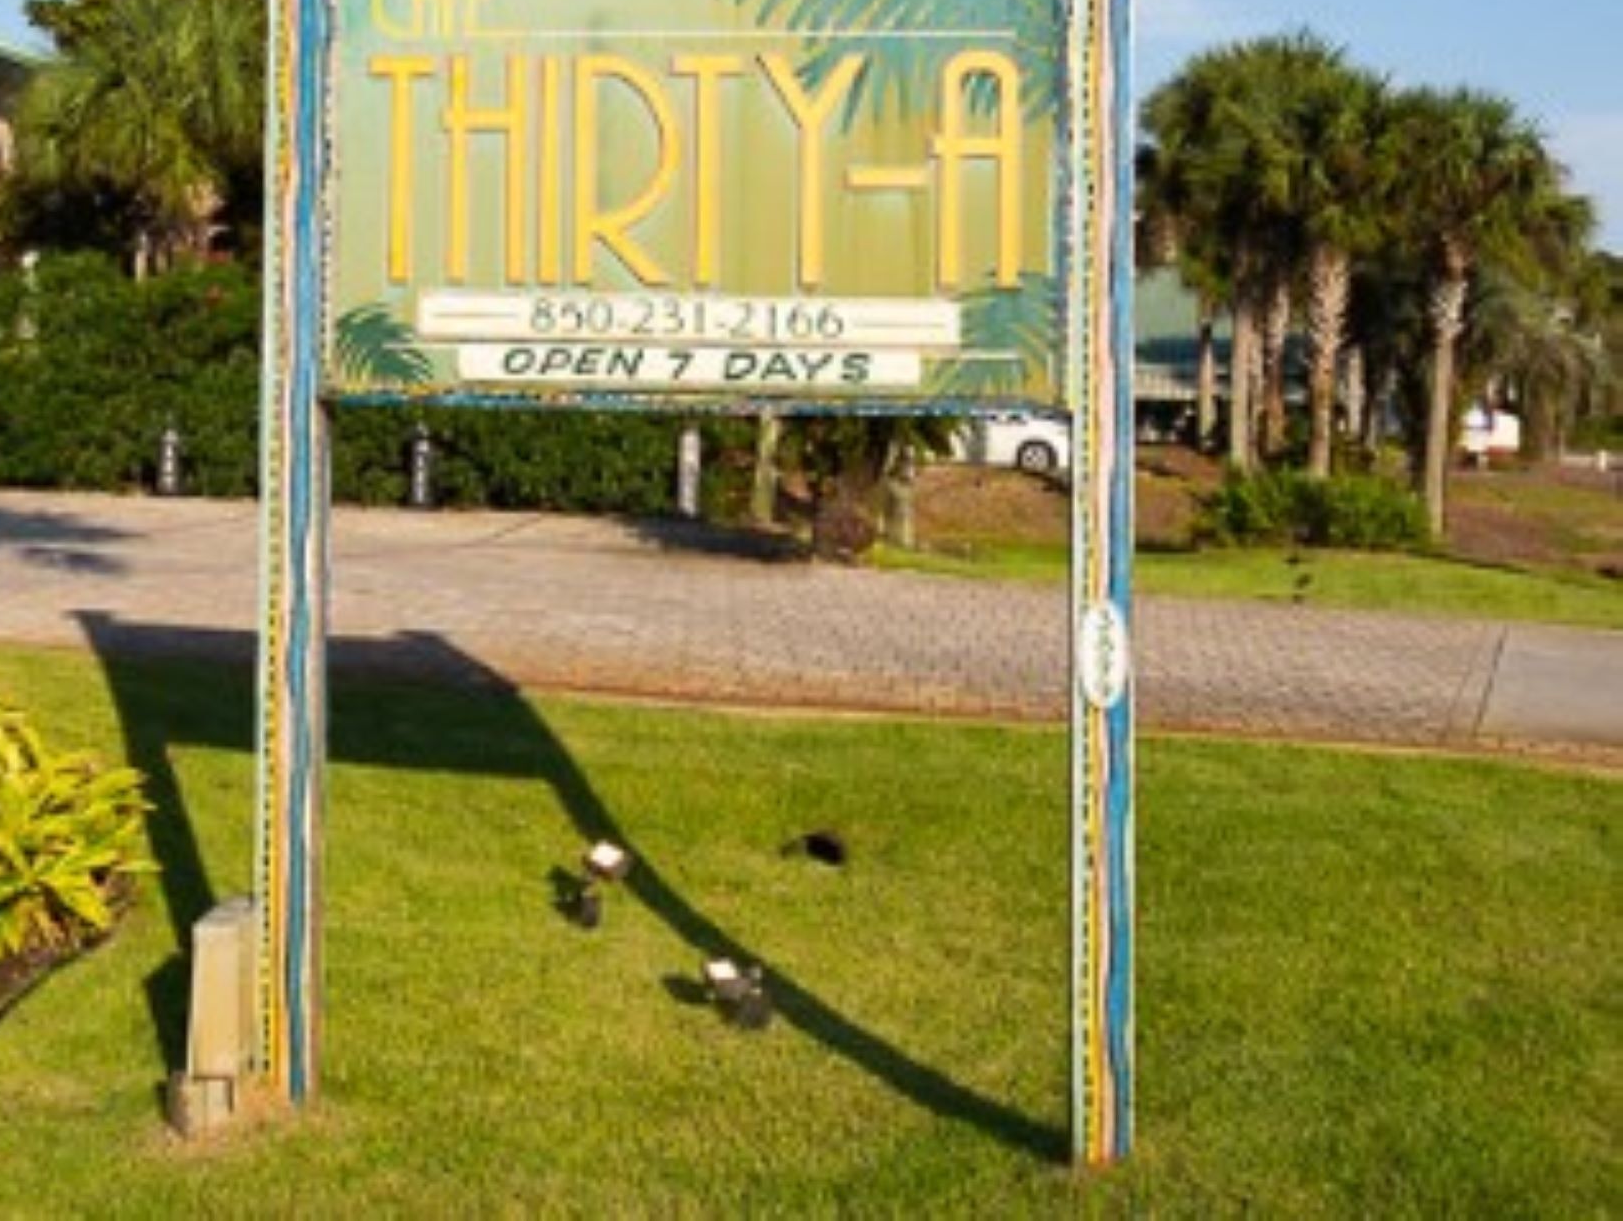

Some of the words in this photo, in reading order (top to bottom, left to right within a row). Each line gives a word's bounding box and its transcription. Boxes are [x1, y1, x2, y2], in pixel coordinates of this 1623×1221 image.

[370, 50, 1024, 289] THIRTY-A
[503, 347, 644, 378] OPEN
[668, 351, 692, 379] 7
[724, 353, 872, 382] DAYS
